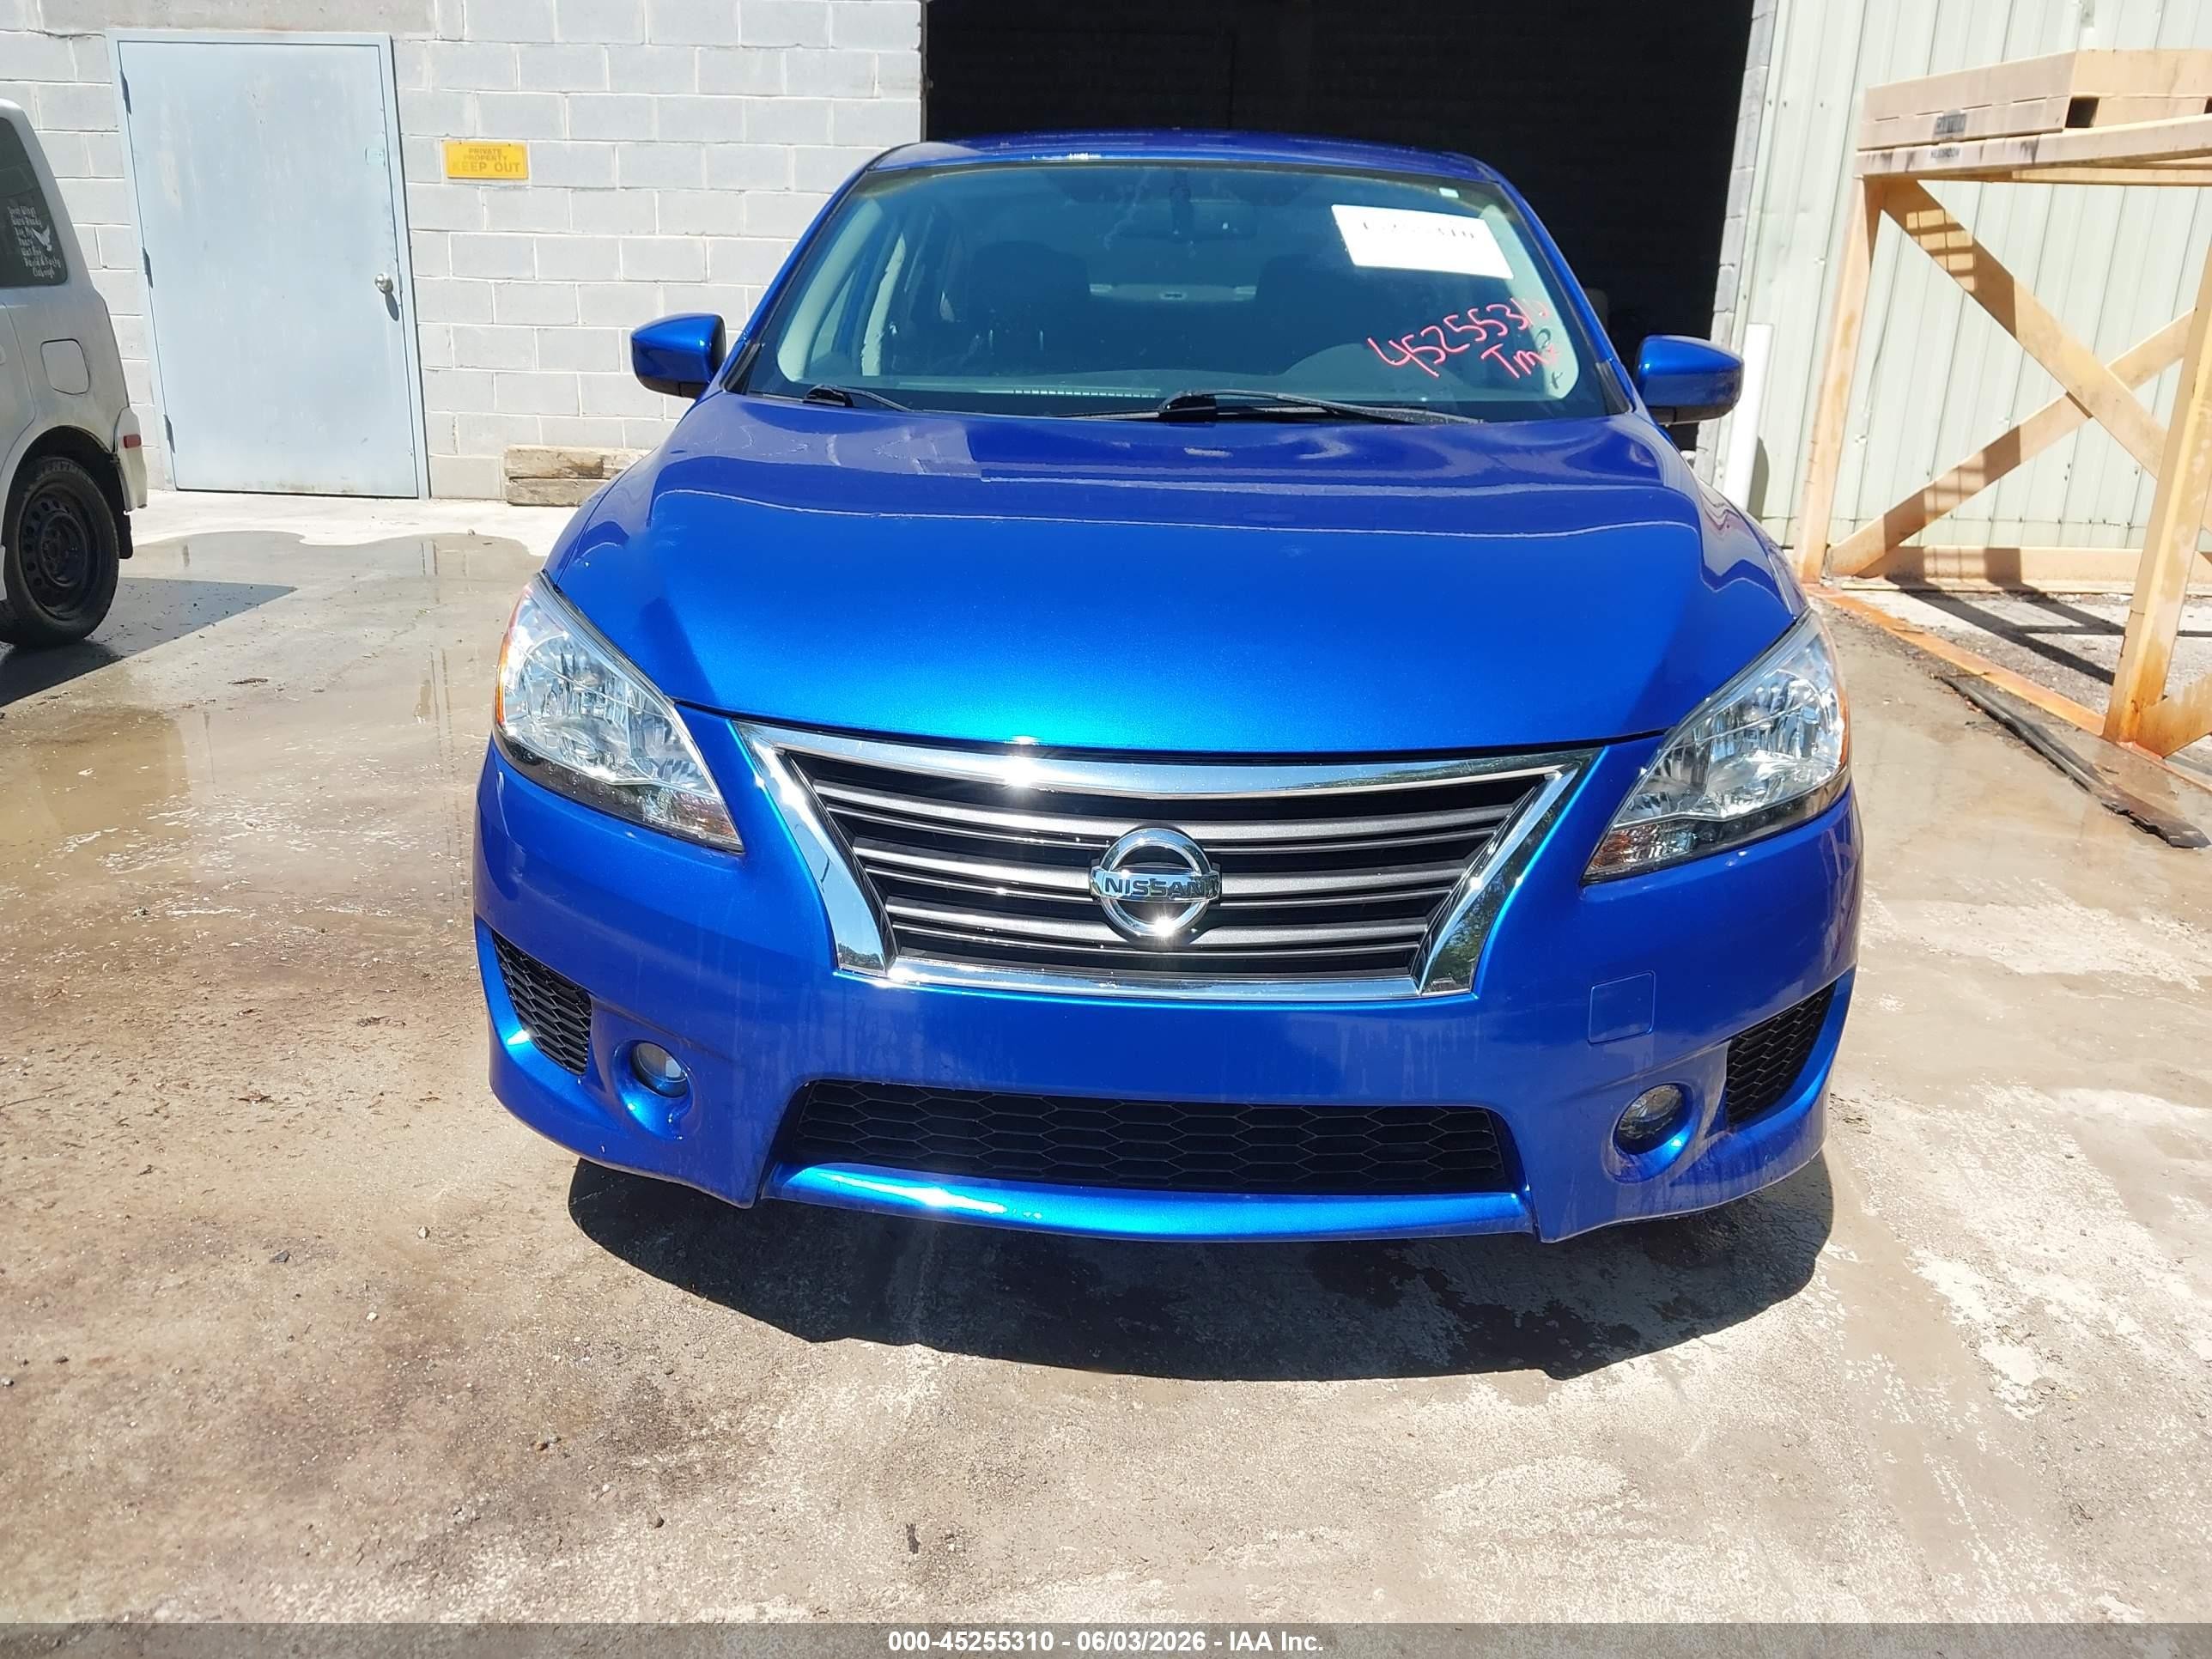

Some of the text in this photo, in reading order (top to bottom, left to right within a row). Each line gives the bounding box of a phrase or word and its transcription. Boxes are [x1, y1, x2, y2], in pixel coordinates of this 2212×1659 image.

[453, 161, 520, 173] KEEP OUT
[1104, 877, 1204, 896] NISSAN
